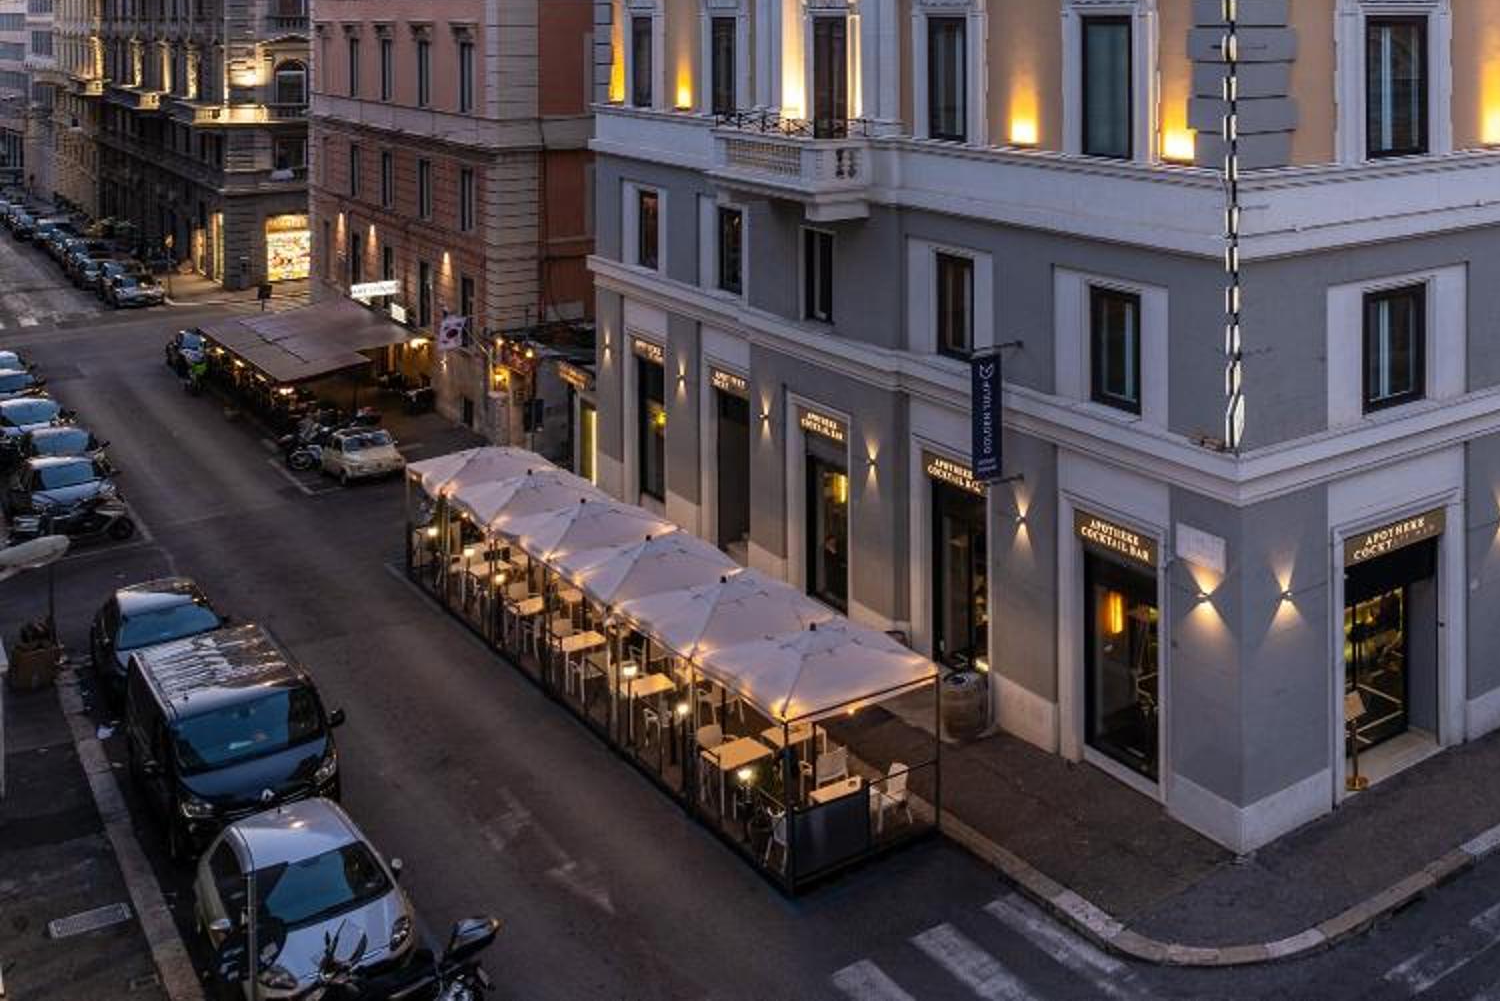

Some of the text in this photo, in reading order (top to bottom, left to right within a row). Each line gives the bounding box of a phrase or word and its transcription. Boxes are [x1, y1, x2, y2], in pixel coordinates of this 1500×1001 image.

[1080, 525, 1150, 562] COCKTAIL BAR
[1089, 519, 1140, 547] APOTHEKE
[1364, 516, 1425, 547] APOTHEKE
